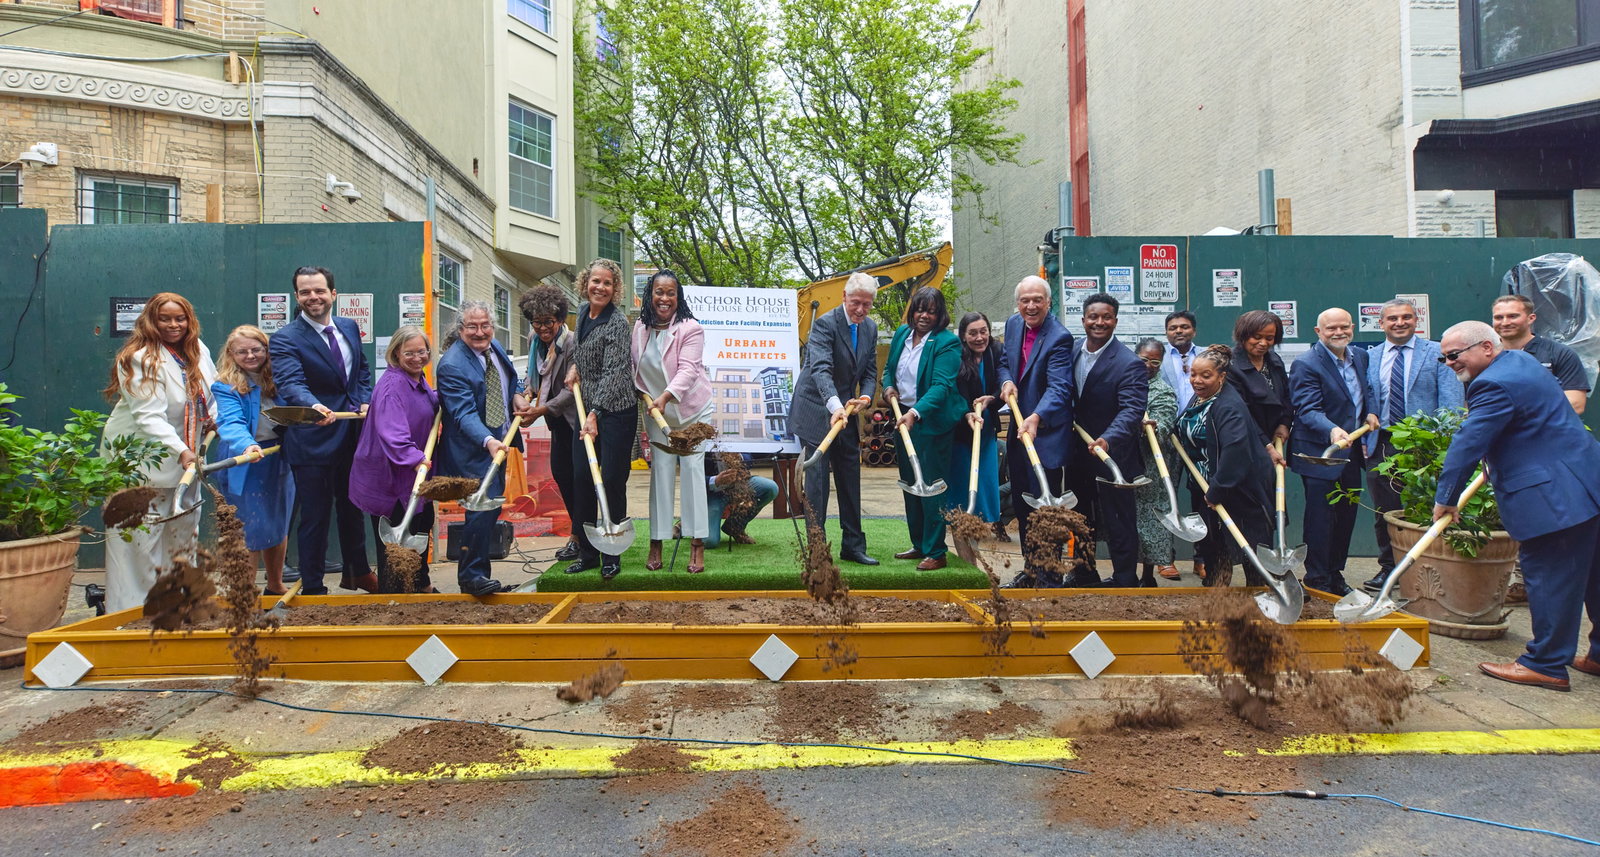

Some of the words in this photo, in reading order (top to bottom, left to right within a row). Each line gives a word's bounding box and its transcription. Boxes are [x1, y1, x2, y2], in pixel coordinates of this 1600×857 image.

[1152, 248, 1166, 257] NO
[1144, 259, 1175, 268] PARKING
[350, 298, 360, 307] NO
[685, 294, 742, 305] ANCHOR
[746, 296, 790, 306] HOUSE
[340, 307, 369, 316] PARKING
[708, 304, 743, 312] HOUSE
[746, 305, 760, 313] OF
[763, 305, 790, 314] HOPE
[724, 338, 776, 348] URBAHN
[717, 350, 787, 360] ARCHITECTS
